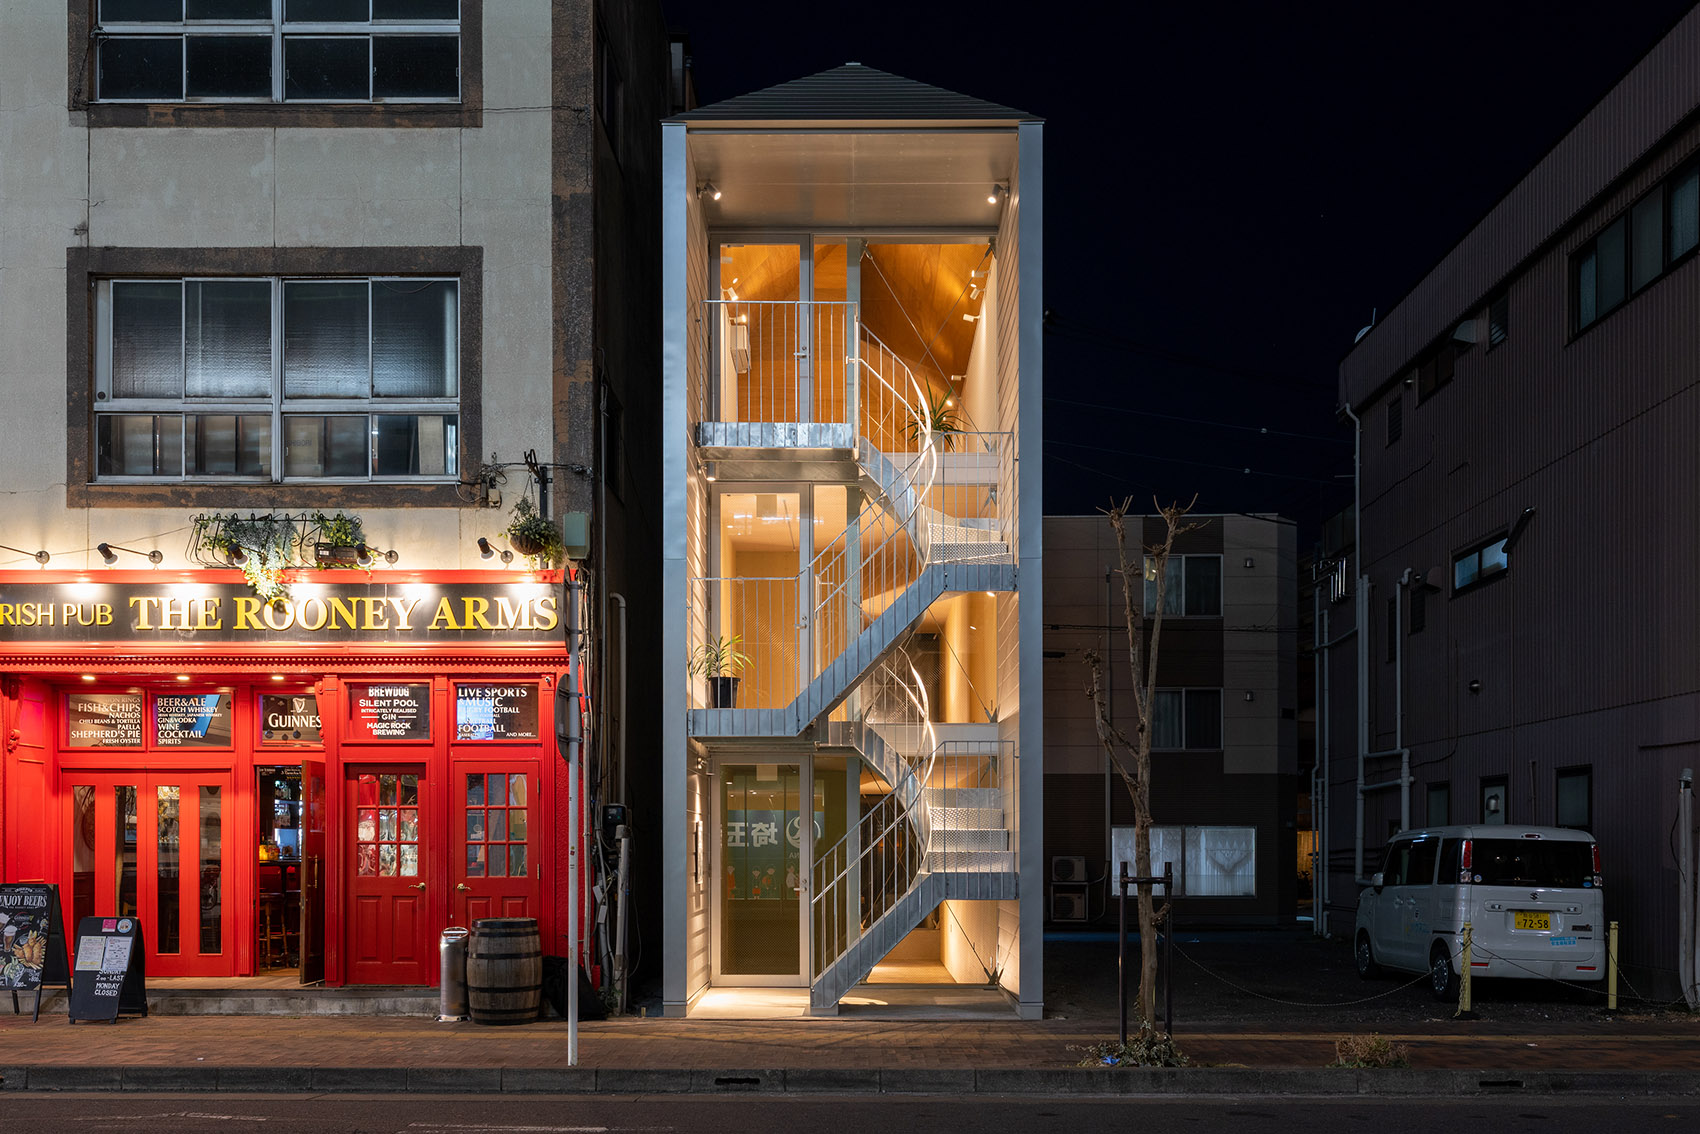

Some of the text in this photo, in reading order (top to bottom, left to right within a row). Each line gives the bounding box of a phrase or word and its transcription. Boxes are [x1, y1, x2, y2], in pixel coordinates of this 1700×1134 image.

[63, 603, 113, 626] PUB
[129, 596, 222, 631] THE
[233, 596, 421, 631] ROONEY
[427, 596, 558, 631] ARMS
[368, 686, 410, 697] BREWDOG
[458, 687, 528, 698] LIVE SPORTS
[157, 697, 207, 707] BEER&ALE
[359, 699, 419, 707] SILENT POOL
[78, 703, 141, 713] FISH&CHIPS
[484, 706, 520, 714] FOOTBALL
[158, 723, 180, 731] WINE
[367, 722, 411, 730] MAGIC ROCK
[458, 724, 506, 733] FOOTBALL
[71, 730, 141, 739] SHEPHERD'S PIE
[158, 730, 203, 739] COCKTAIL
[1523, 918, 1549, 929] 72-58
[96, 982, 121, 990] MONDAY
[94, 989, 118, 997] CLOSED
